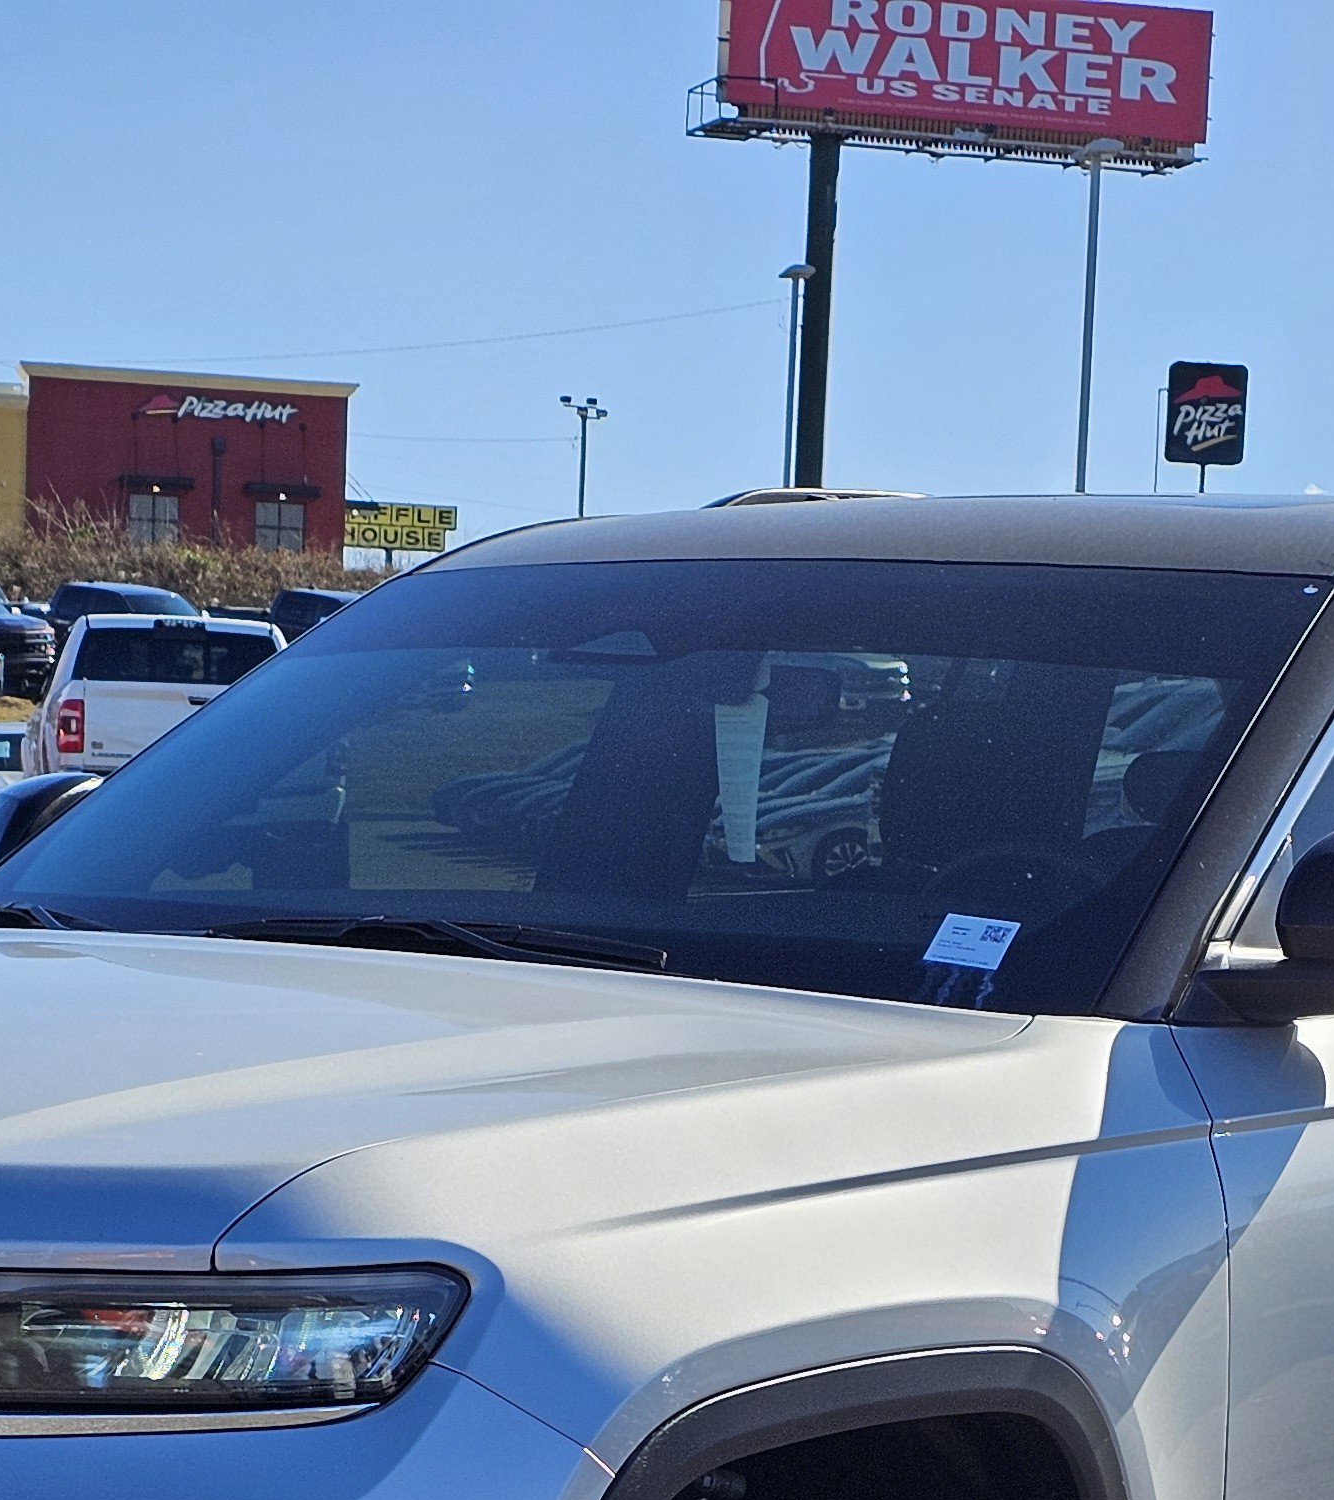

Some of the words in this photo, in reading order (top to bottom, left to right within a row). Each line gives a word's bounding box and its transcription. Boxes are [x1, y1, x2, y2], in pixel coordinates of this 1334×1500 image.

[831, 0, 1147, 54] RODNEY
[790, 25, 1177, 104] WALKER
[856, 78, 917, 98] US
[932, 84, 1112, 116] SENATE
[177, 396, 245, 419] Pizza
[245, 400, 299, 424] Hut
[1173, 403, 1243, 436] Pizza
[1184, 419, 1235, 446] Hut
[351, 506, 453, 525] FFLE
